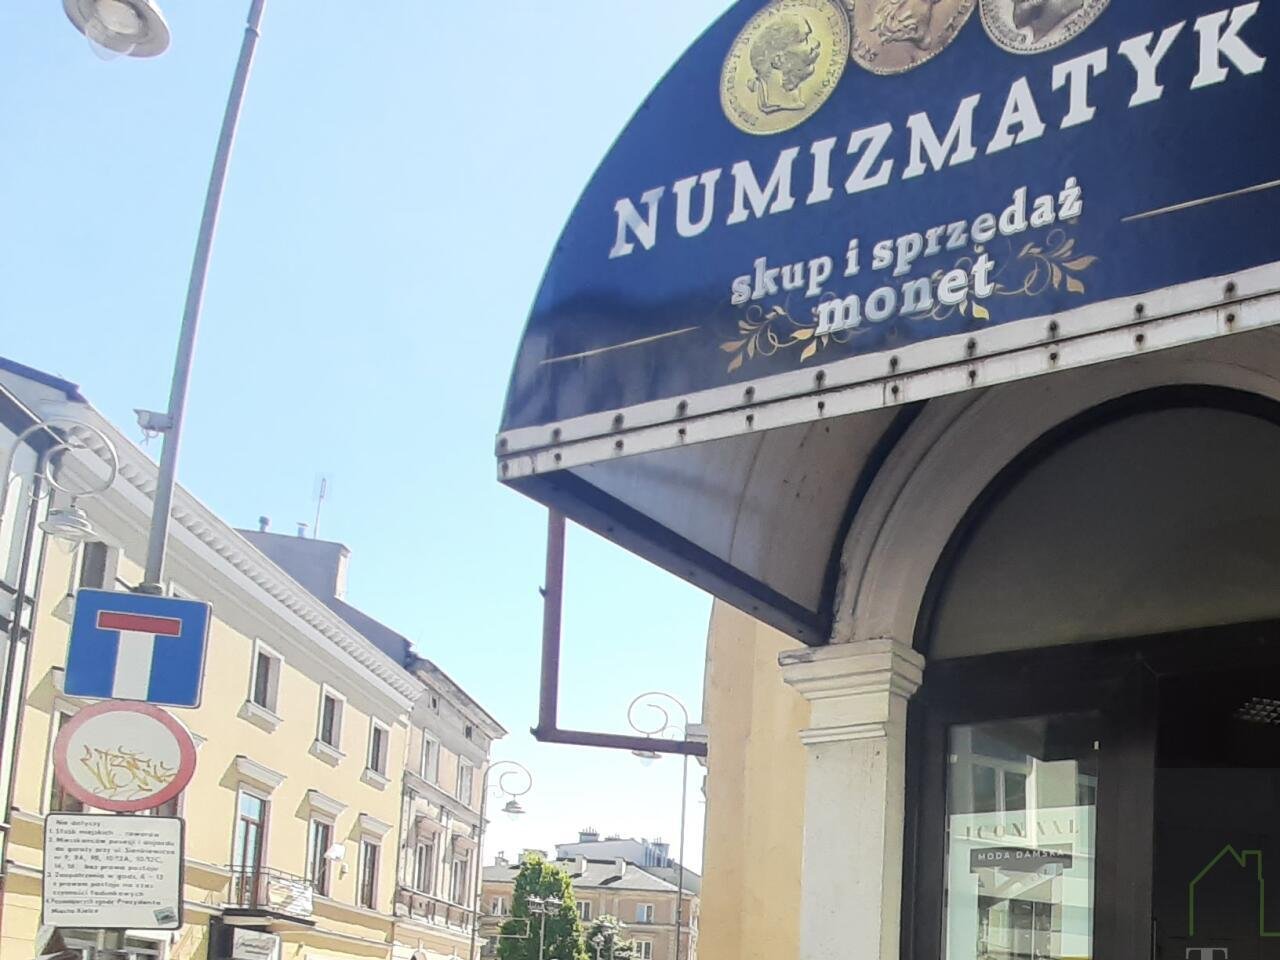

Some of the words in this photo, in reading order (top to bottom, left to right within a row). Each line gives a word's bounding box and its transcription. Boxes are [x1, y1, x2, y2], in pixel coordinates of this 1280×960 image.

[607, 1, 1266, 258] NUMIZMATYK
[730, 252, 832, 306] skup
[845, 238, 862, 279] i
[871, 177, 1084, 271] sprzedaż
[814, 252, 997, 337] monet
[978, 853, 1010, 861] MODA
[1015, 850, 1065, 859] DAMSKA
